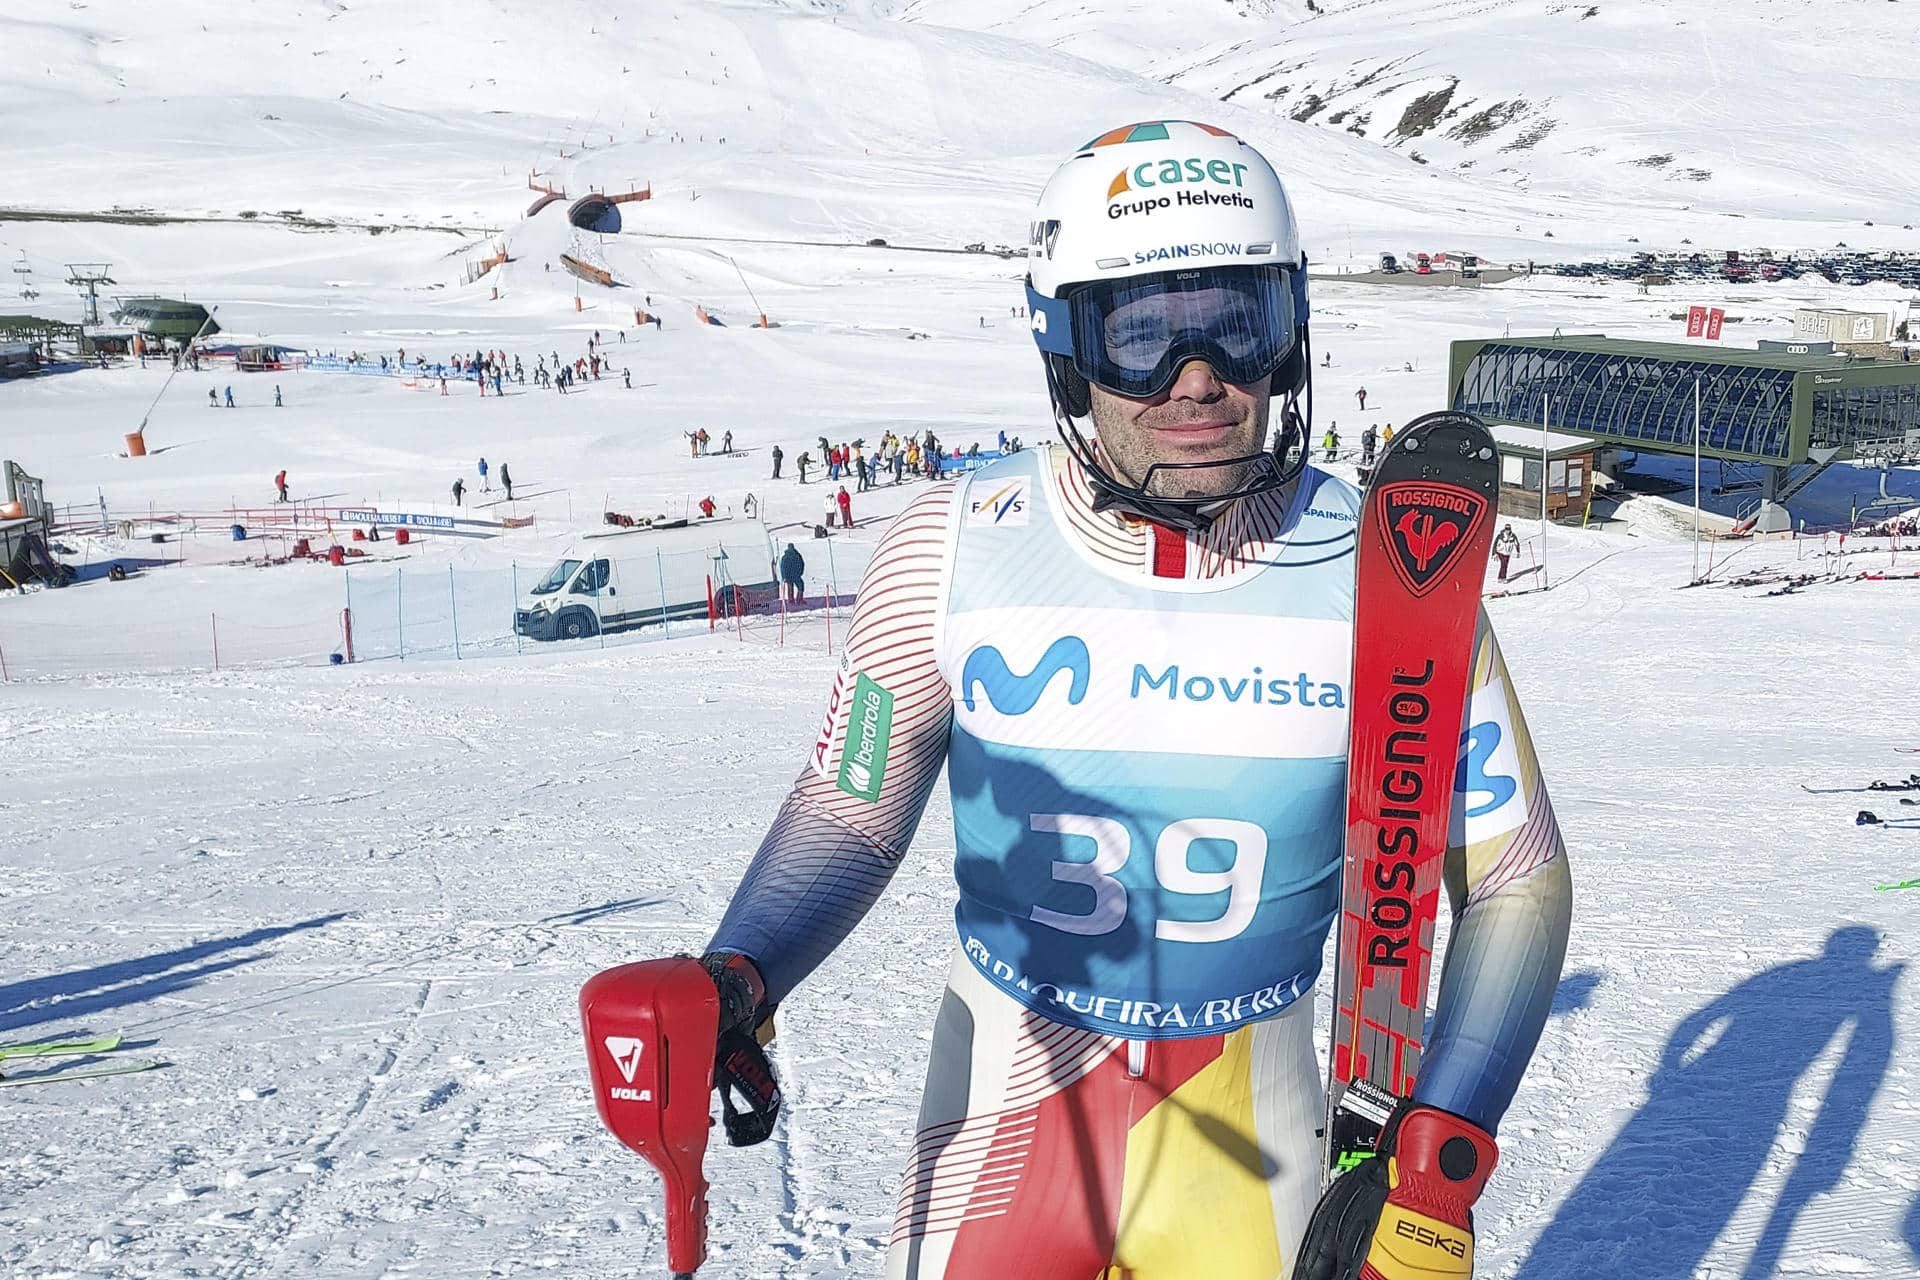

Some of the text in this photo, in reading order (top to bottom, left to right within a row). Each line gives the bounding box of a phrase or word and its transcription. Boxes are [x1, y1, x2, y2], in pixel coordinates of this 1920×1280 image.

[1133, 157, 1248, 188] caser
[1107, 190, 1254, 220] Grupo Helvetia
[1134, 243, 1242, 264] SPAINSNOW
[1304, 507, 1358, 522] SPAINSNO
[1391, 491, 1472, 516] ROSSIGNOL
[1130, 664, 1345, 708] Movista
[854, 690, 881, 766] Iberdrola
[1367, 659, 1434, 967] ROSSIGNOL
[1029, 813, 1268, 943] 39
[611, 1087, 651, 1101] VOLA
